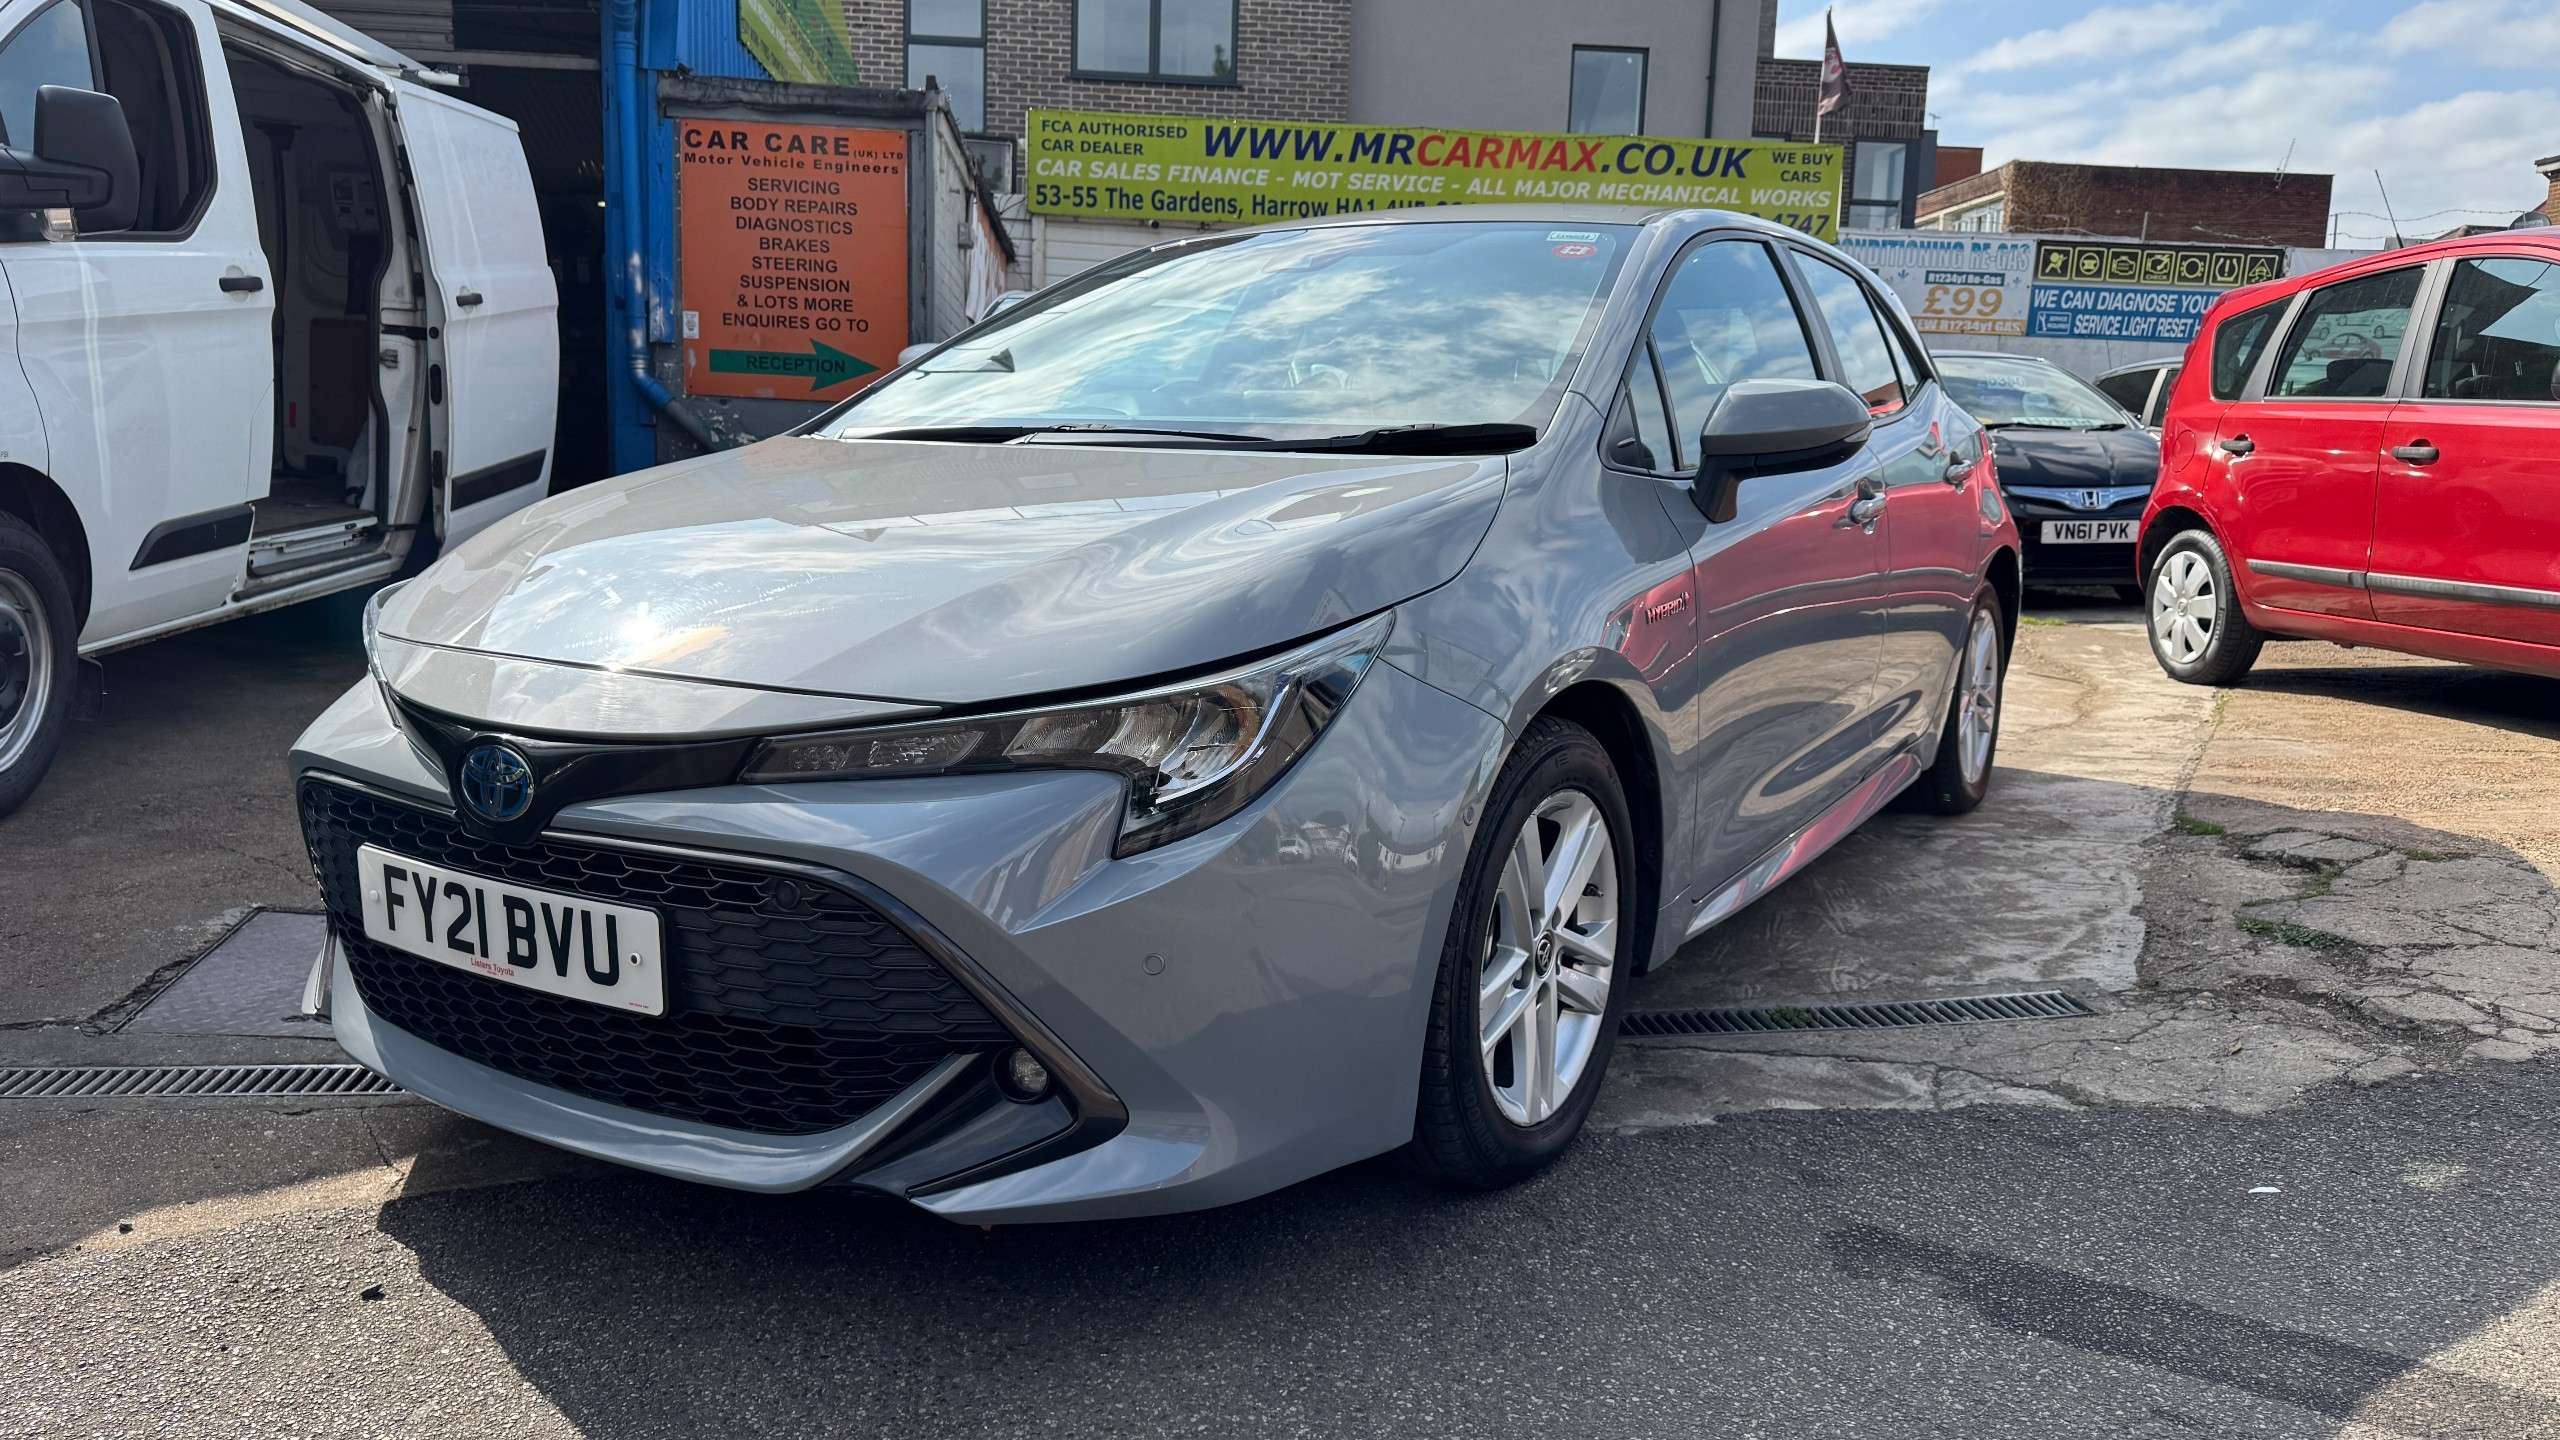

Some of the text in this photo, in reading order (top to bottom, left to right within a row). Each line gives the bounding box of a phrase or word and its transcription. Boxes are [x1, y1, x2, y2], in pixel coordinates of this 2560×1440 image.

[1041, 119, 1188, 140] FCA AUTHORISED
[684, 128, 904, 160] CAR CARE (UK) LTD
[1041, 138, 1144, 157] CAR DEALER
[1203, 124, 1753, 179] WWW.MRCARMAX.CO.UK
[684, 152, 900, 175] Motor Vehicle Engineers
[1772, 151, 1833, 166] WE BUY
[747, 177, 841, 196] SERVICING
[1035, 158, 1083, 177] CAR
[1088, 160, 1162, 182] SALES
[1167, 164, 1270, 187] FINANCE
[1291, 171, 1342, 190] MOT
[1347, 172, 1446, 193] SERVICE
[1465, 176, 1506, 196] ALL
[1513, 179, 1589, 200] MAJOR
[1596, 183, 1742, 205] MECHANICAL
[1750, 188, 1832, 208] WORKS
[1780, 169, 1822, 184] CARS
[730, 196, 858, 217] BODY REPAIRS
[1035, 184, 1098, 208] 53-55
[1106, 187, 1144, 210] The
[1151, 189, 1243, 218] Gardens,
[1252, 194, 1328, 217] Harrow
[736, 216, 854, 236] DIAGNOSTICS
[759, 237, 831, 254] BRAKES
[1842, 238, 1965, 267] ONDITIONING
[752, 255, 839, 274] STEERING
[740, 275, 851, 294] SUSPENSION
[737, 294, 854, 313] & LOTS MORE
[1922, 285, 2003, 316] £99
[2033, 289, 2217, 314] WE CAN DIAGNOSE YOU
[722, 312, 869, 333] ENQUIRES GO TO
[2074, 314, 2121, 336] SERVICE
[2122, 316, 2153, 337] LIGHT
[2153, 318, 2193, 338] RESET
[746, 355, 846, 374] RECEPTION
[2054, 523, 2129, 540] VN61 PVK
[383, 863, 620, 987] FY21 BVU
